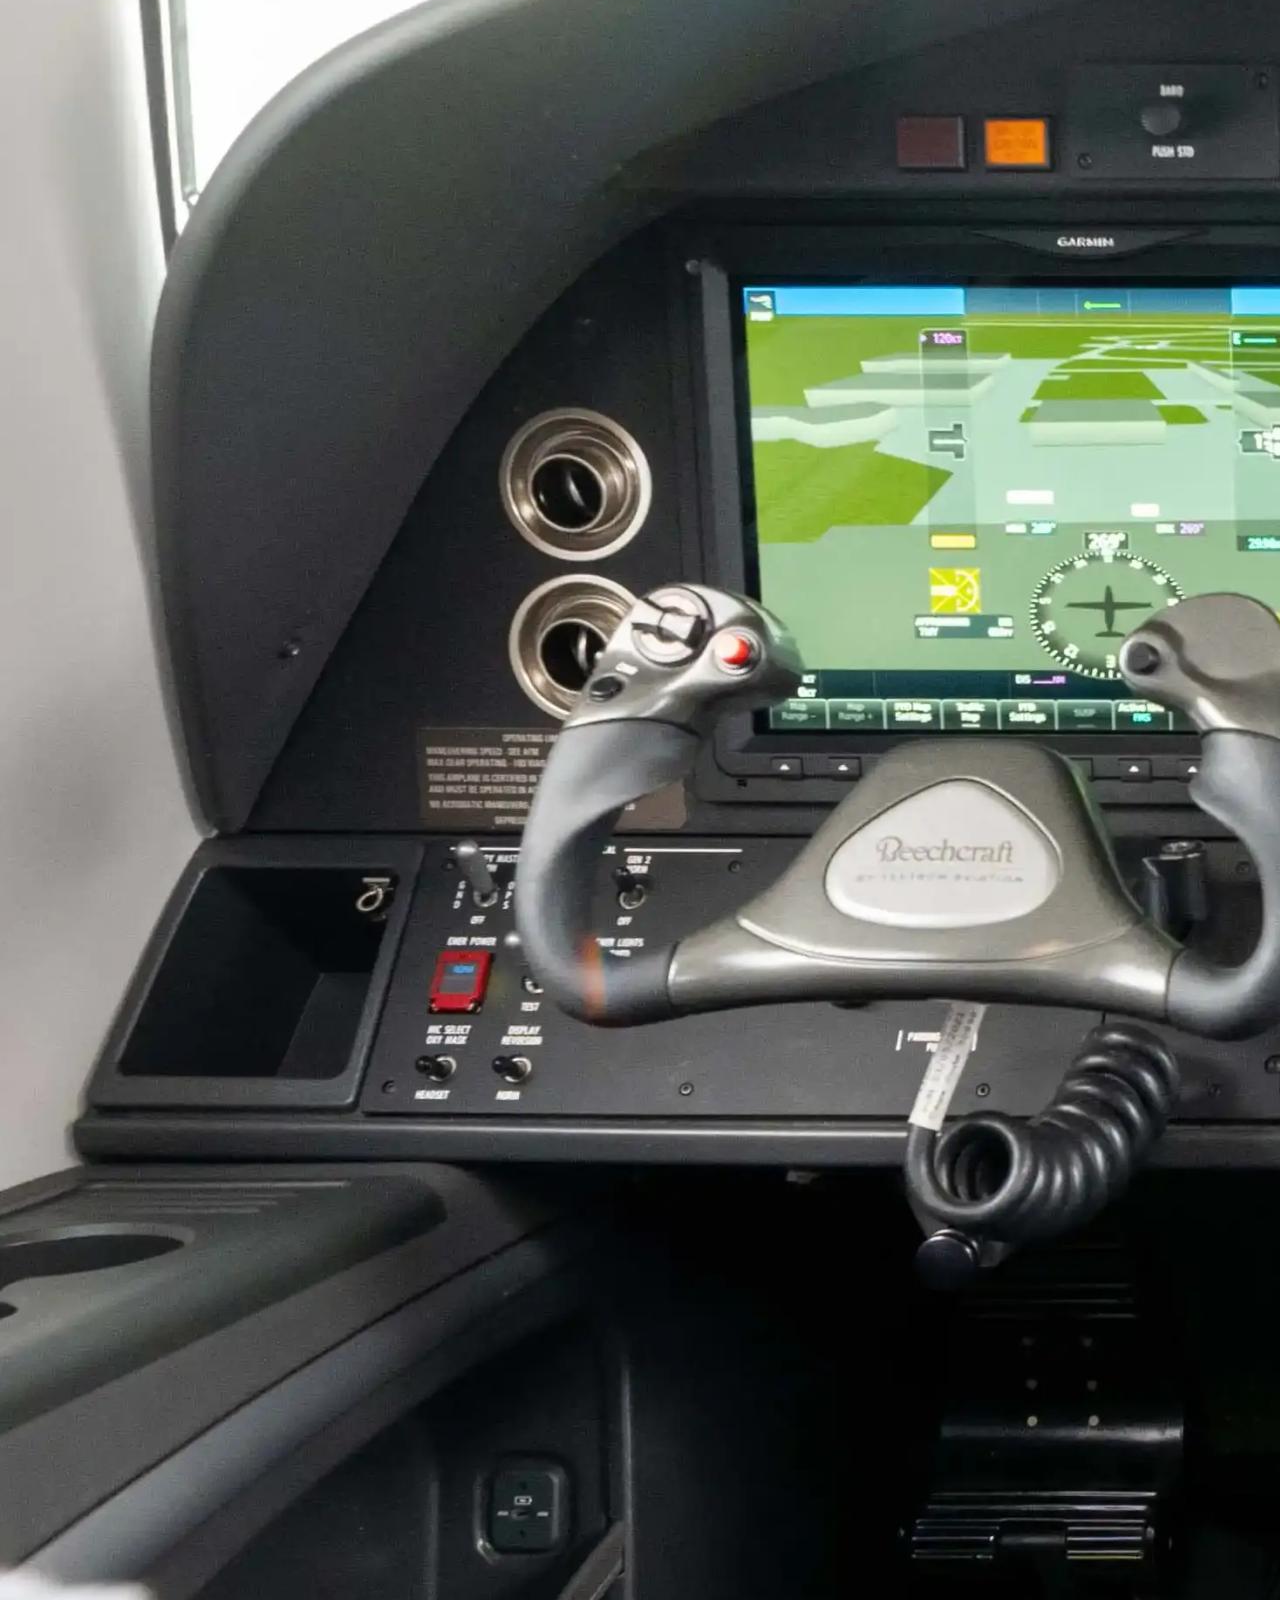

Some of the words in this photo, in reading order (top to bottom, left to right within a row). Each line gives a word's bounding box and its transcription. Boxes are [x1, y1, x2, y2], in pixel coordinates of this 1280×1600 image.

[1152, 145, 1175, 158] PUSH
[1177, 145, 1194, 158] STD
[1057, 237, 1114, 247] GARMIN
[876, 836, 1012, 863] Beechcraft
[470, 916, 485, 924] OFF
[617, 917, 632, 925] OFF
